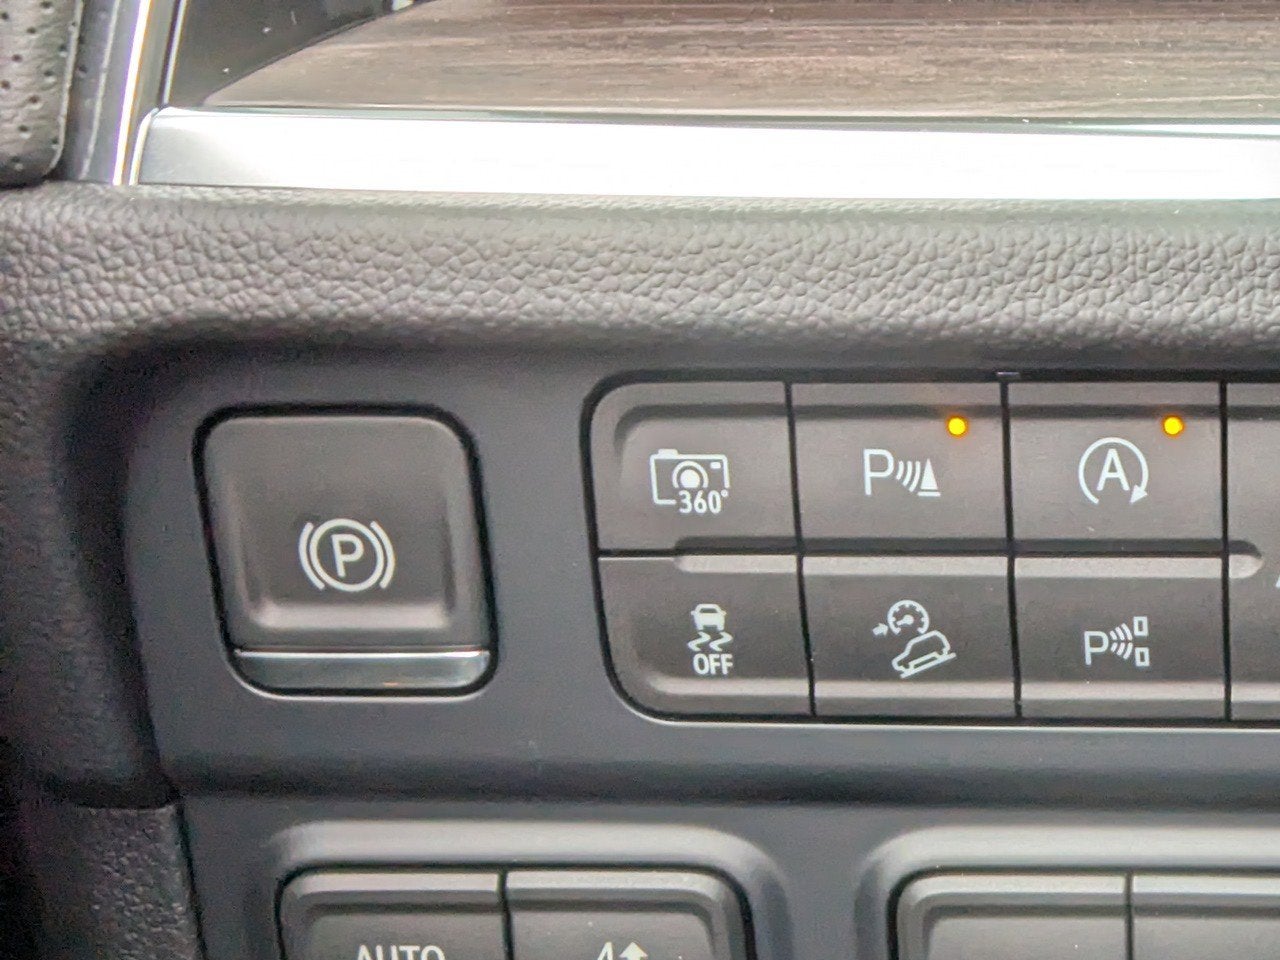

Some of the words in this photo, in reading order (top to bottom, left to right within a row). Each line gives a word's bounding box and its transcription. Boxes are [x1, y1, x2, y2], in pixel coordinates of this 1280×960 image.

[864, 449, 894, 496] P
[1096, 448, 1131, 491] A
[331, 533, 365, 578] P
[694, 650, 733, 675] OFF
[1084, 631, 1108, 666] P
